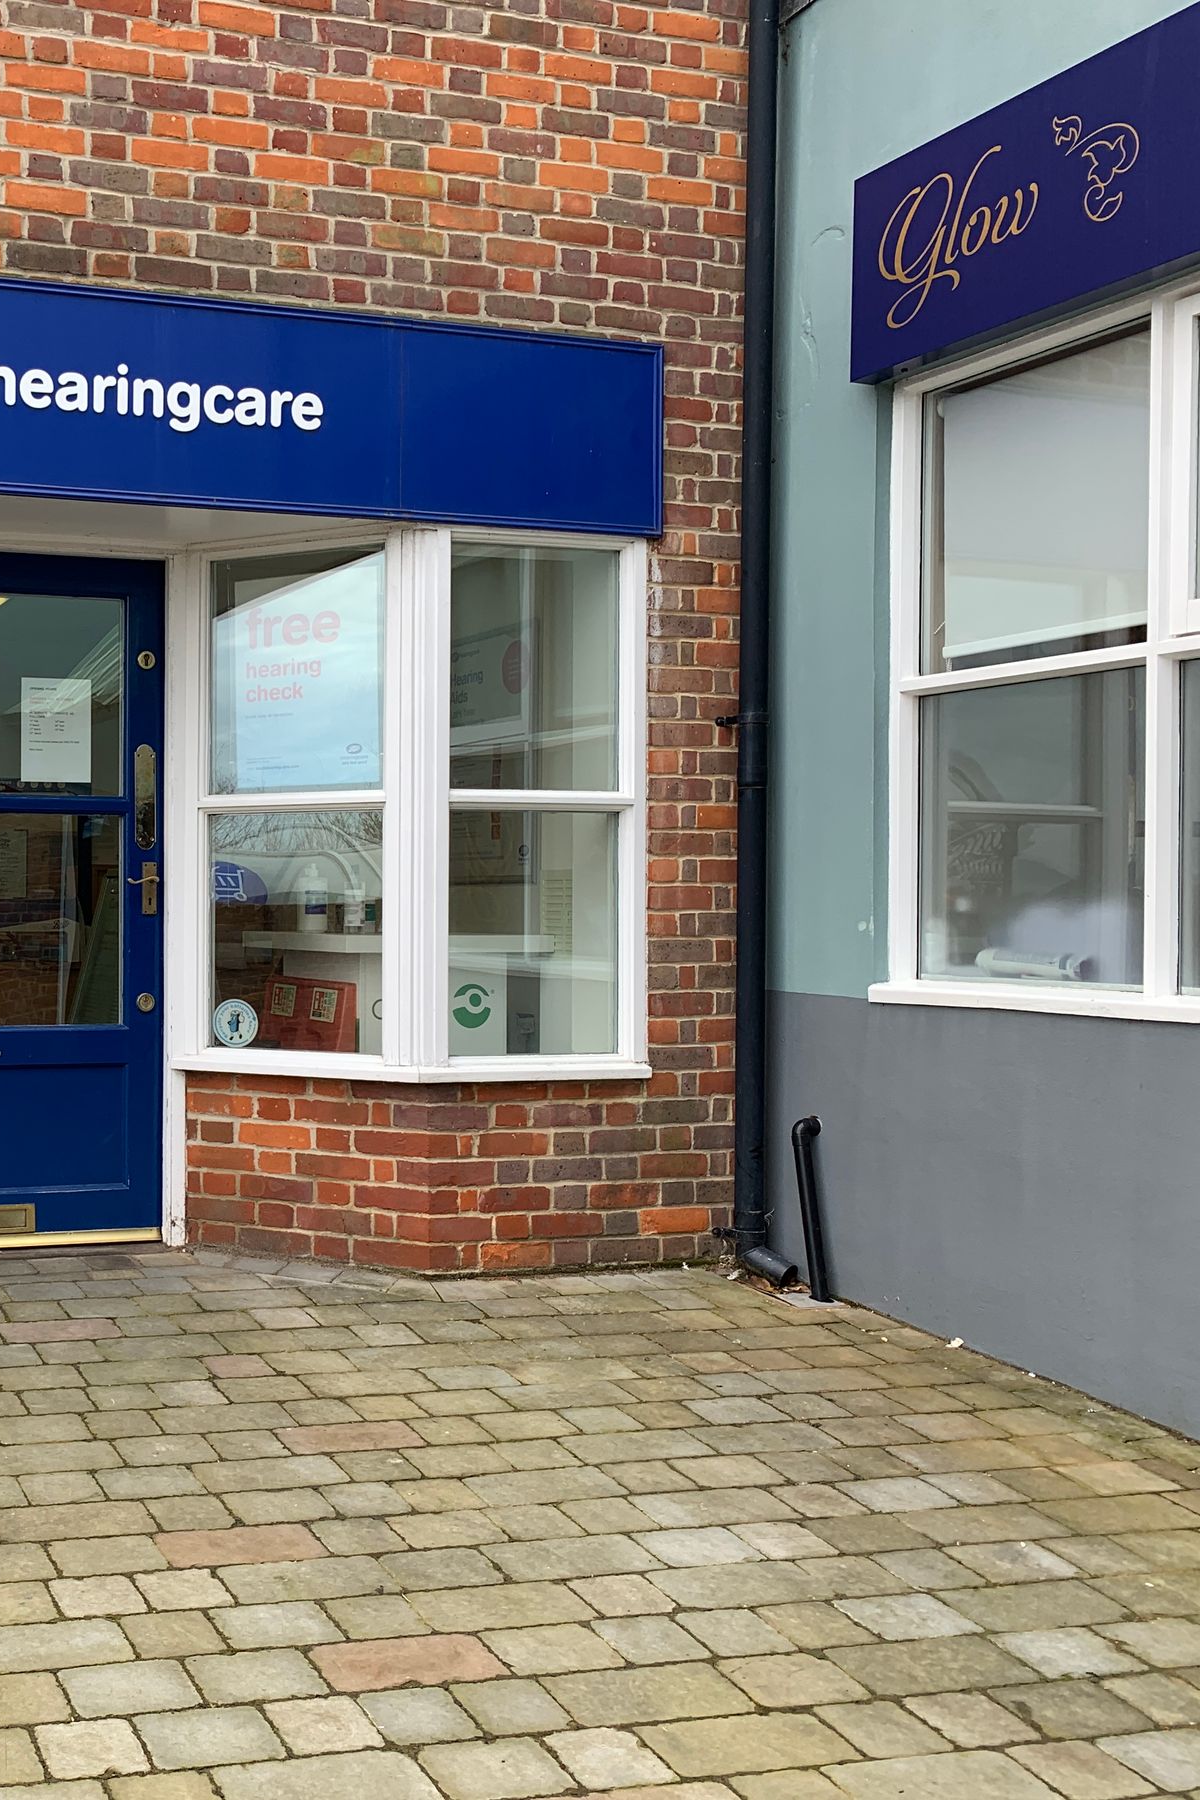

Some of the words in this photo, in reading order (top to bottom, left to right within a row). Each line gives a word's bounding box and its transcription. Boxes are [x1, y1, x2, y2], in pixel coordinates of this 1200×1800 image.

[878, 145, 1039, 328] Glow
[245, 607, 341, 650] free
[246, 658, 322, 678] hearing
[246, 682, 303, 702] check
